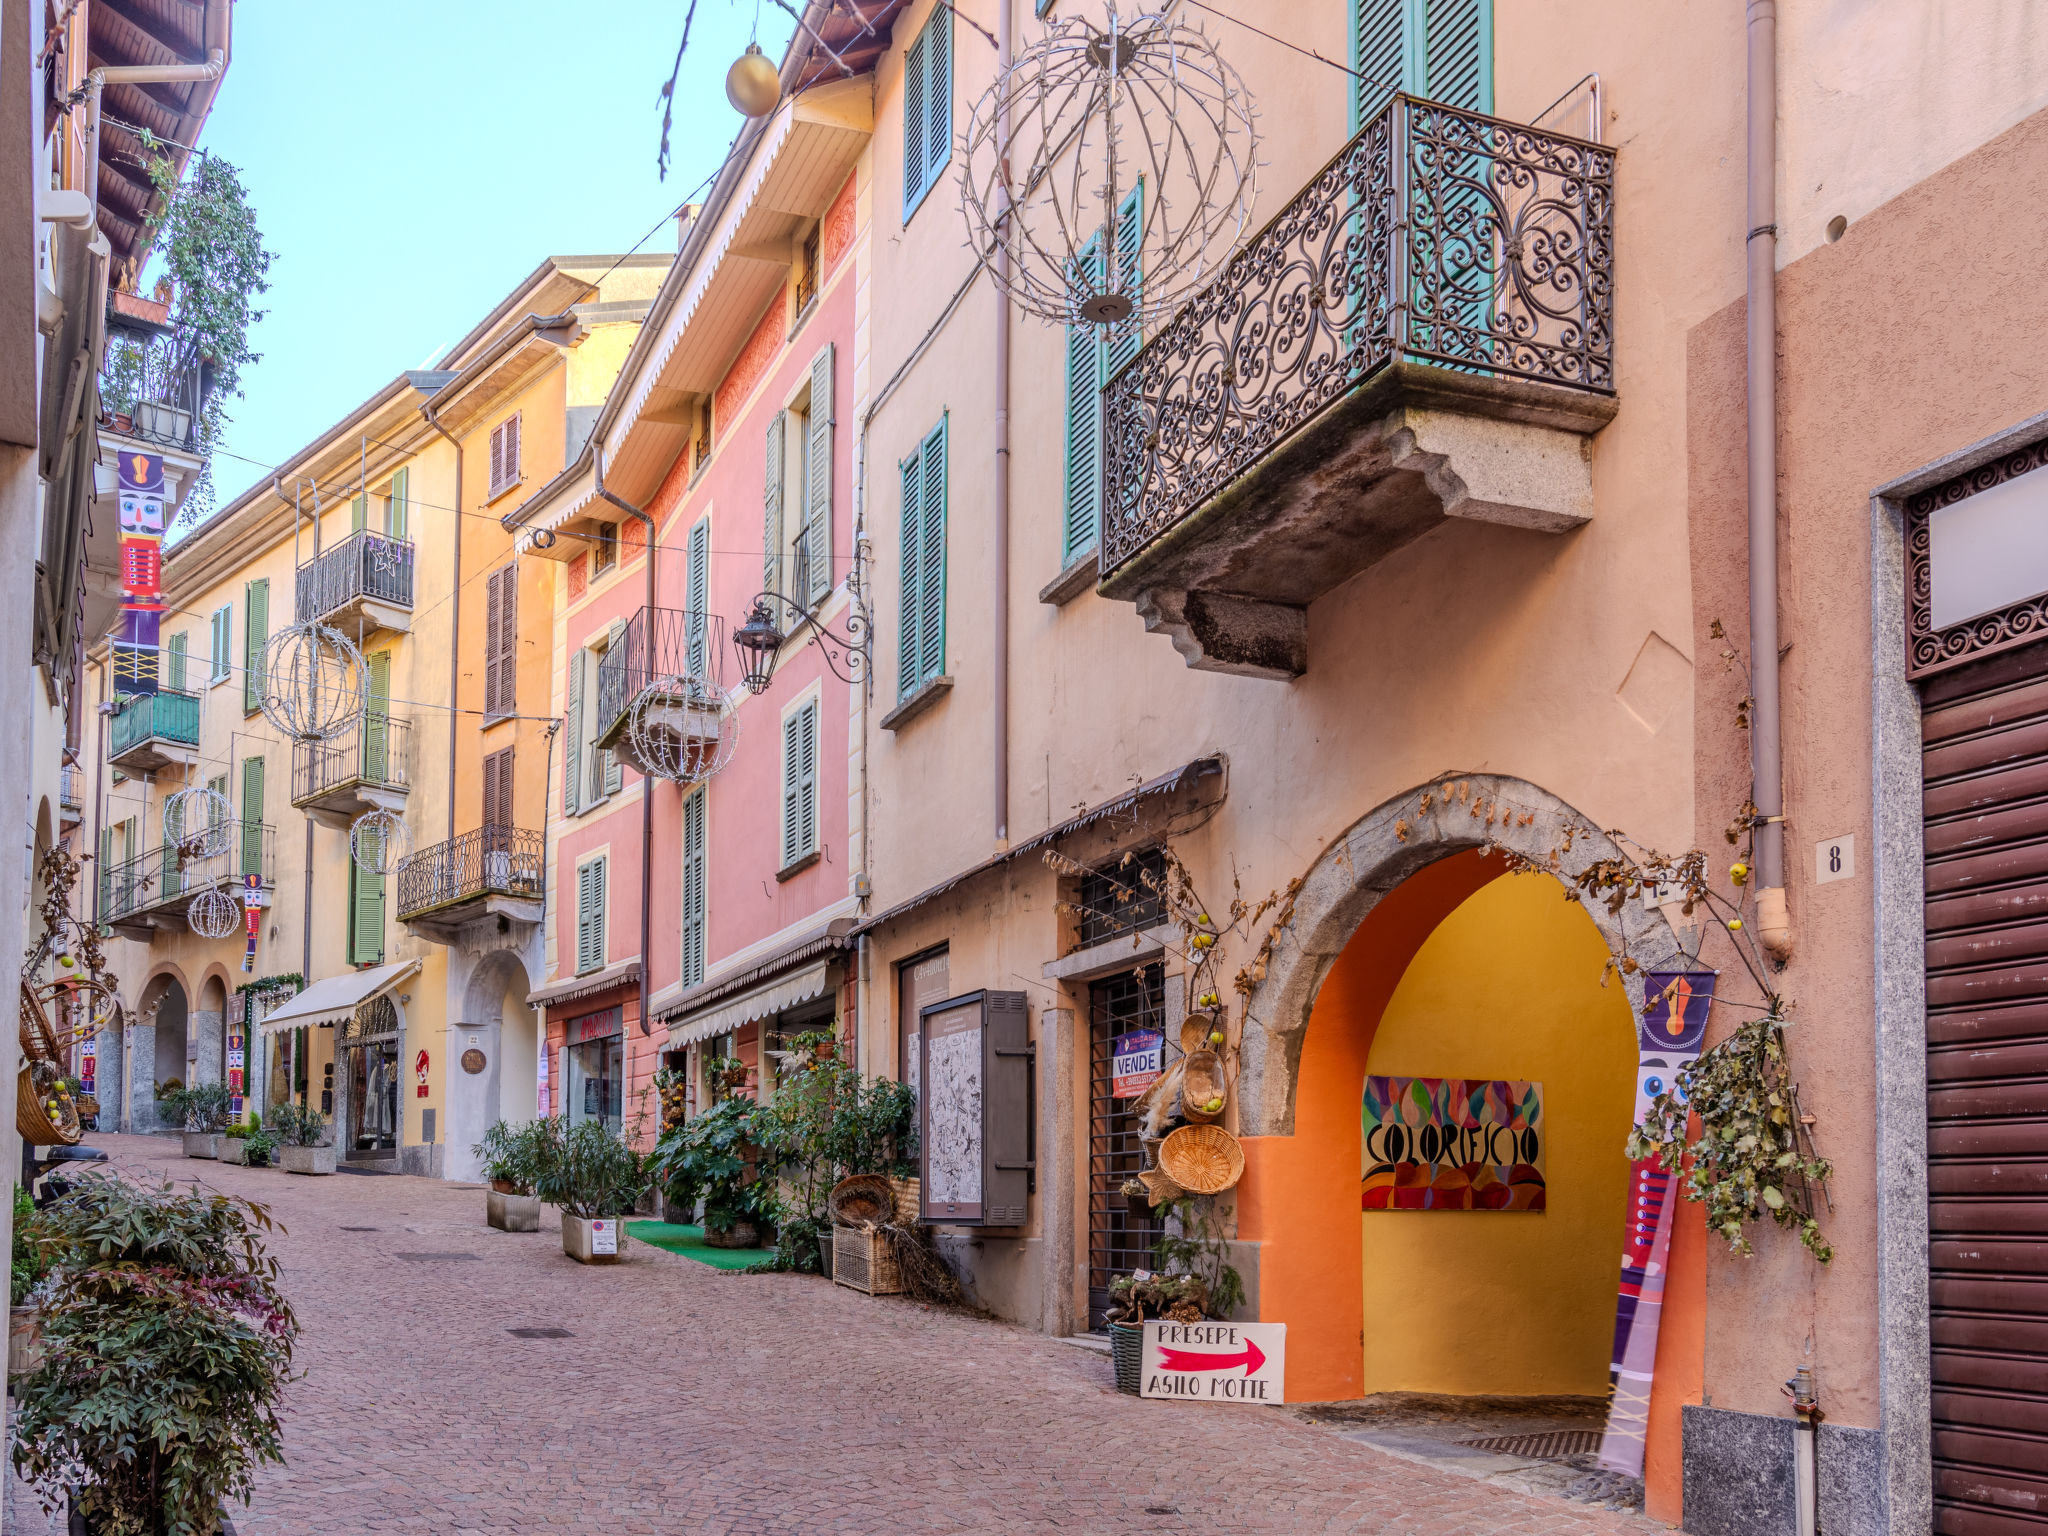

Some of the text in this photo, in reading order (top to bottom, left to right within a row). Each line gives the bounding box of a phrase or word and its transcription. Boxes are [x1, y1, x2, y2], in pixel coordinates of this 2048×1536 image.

[1829, 845, 1842, 873] 8
[1118, 1052, 1156, 1075] VENDE
[1366, 1121, 1539, 1169] COLORIFICIO
[1157, 1325, 1239, 1345] PRESEPE
[1147, 1375, 1270, 1400] ASILO MOTTE
